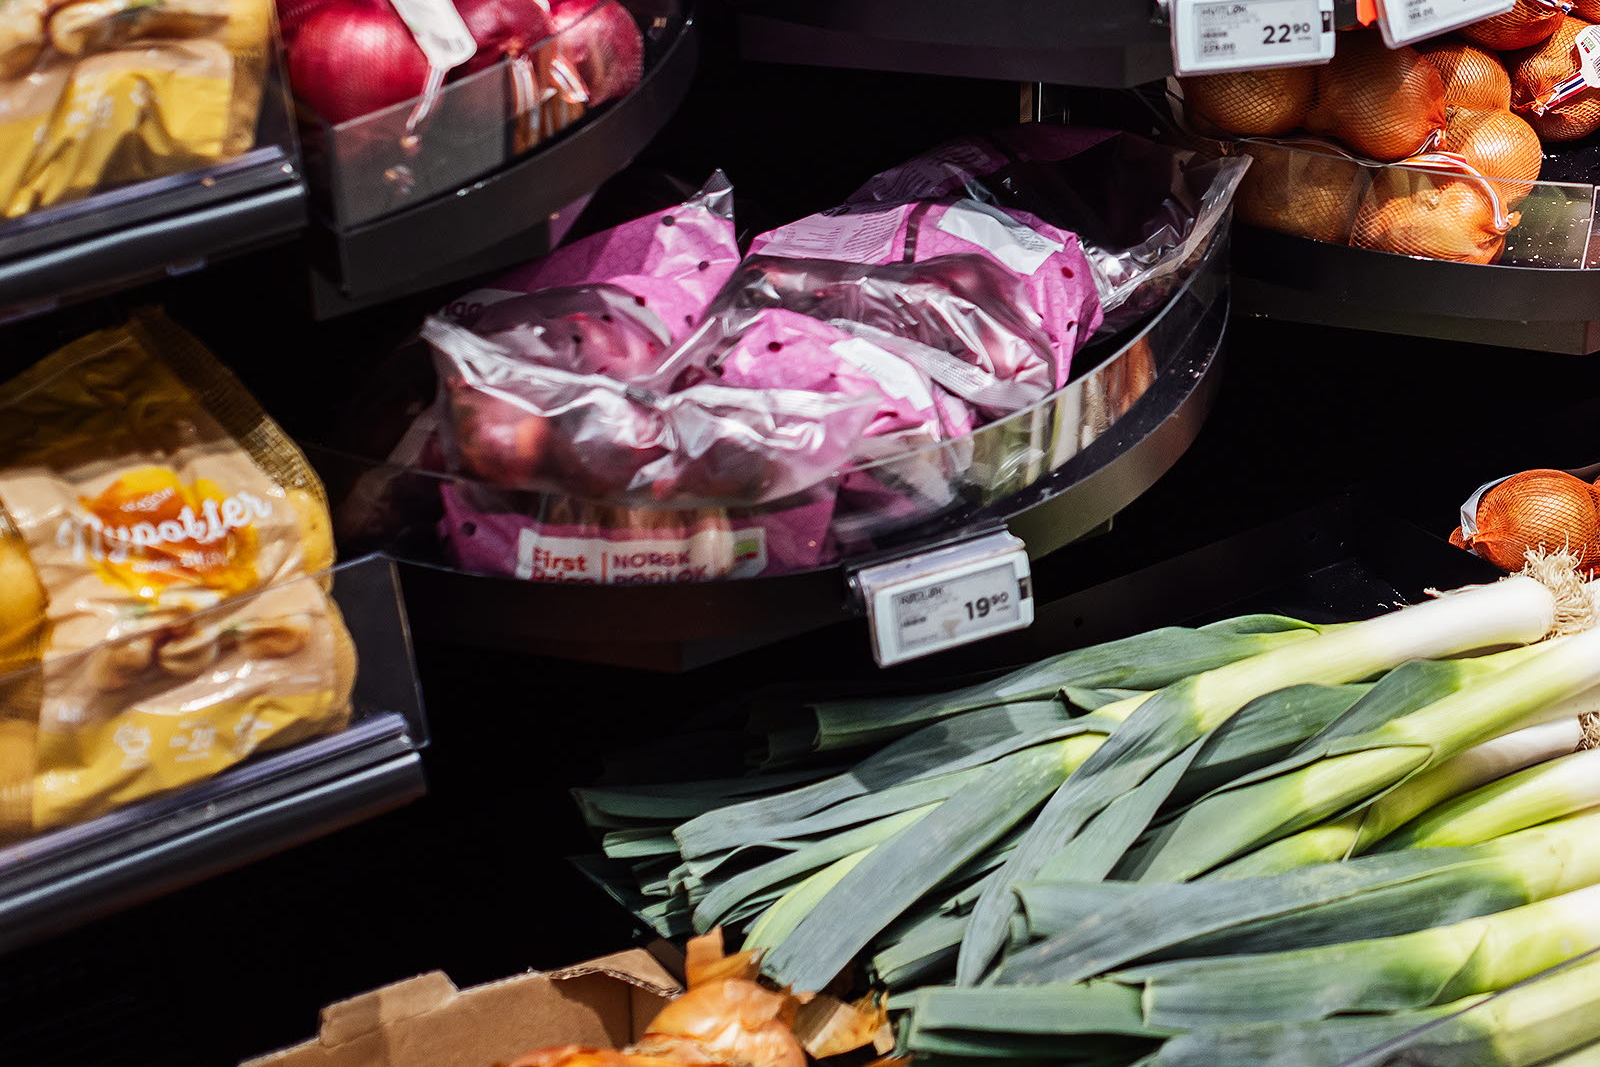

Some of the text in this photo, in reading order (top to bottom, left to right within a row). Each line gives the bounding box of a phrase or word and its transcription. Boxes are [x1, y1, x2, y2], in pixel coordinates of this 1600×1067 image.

[1262, 23, 1311, 44] 2290
[532, 546, 588, 573] First
[612, 550, 694, 570] NORSK
